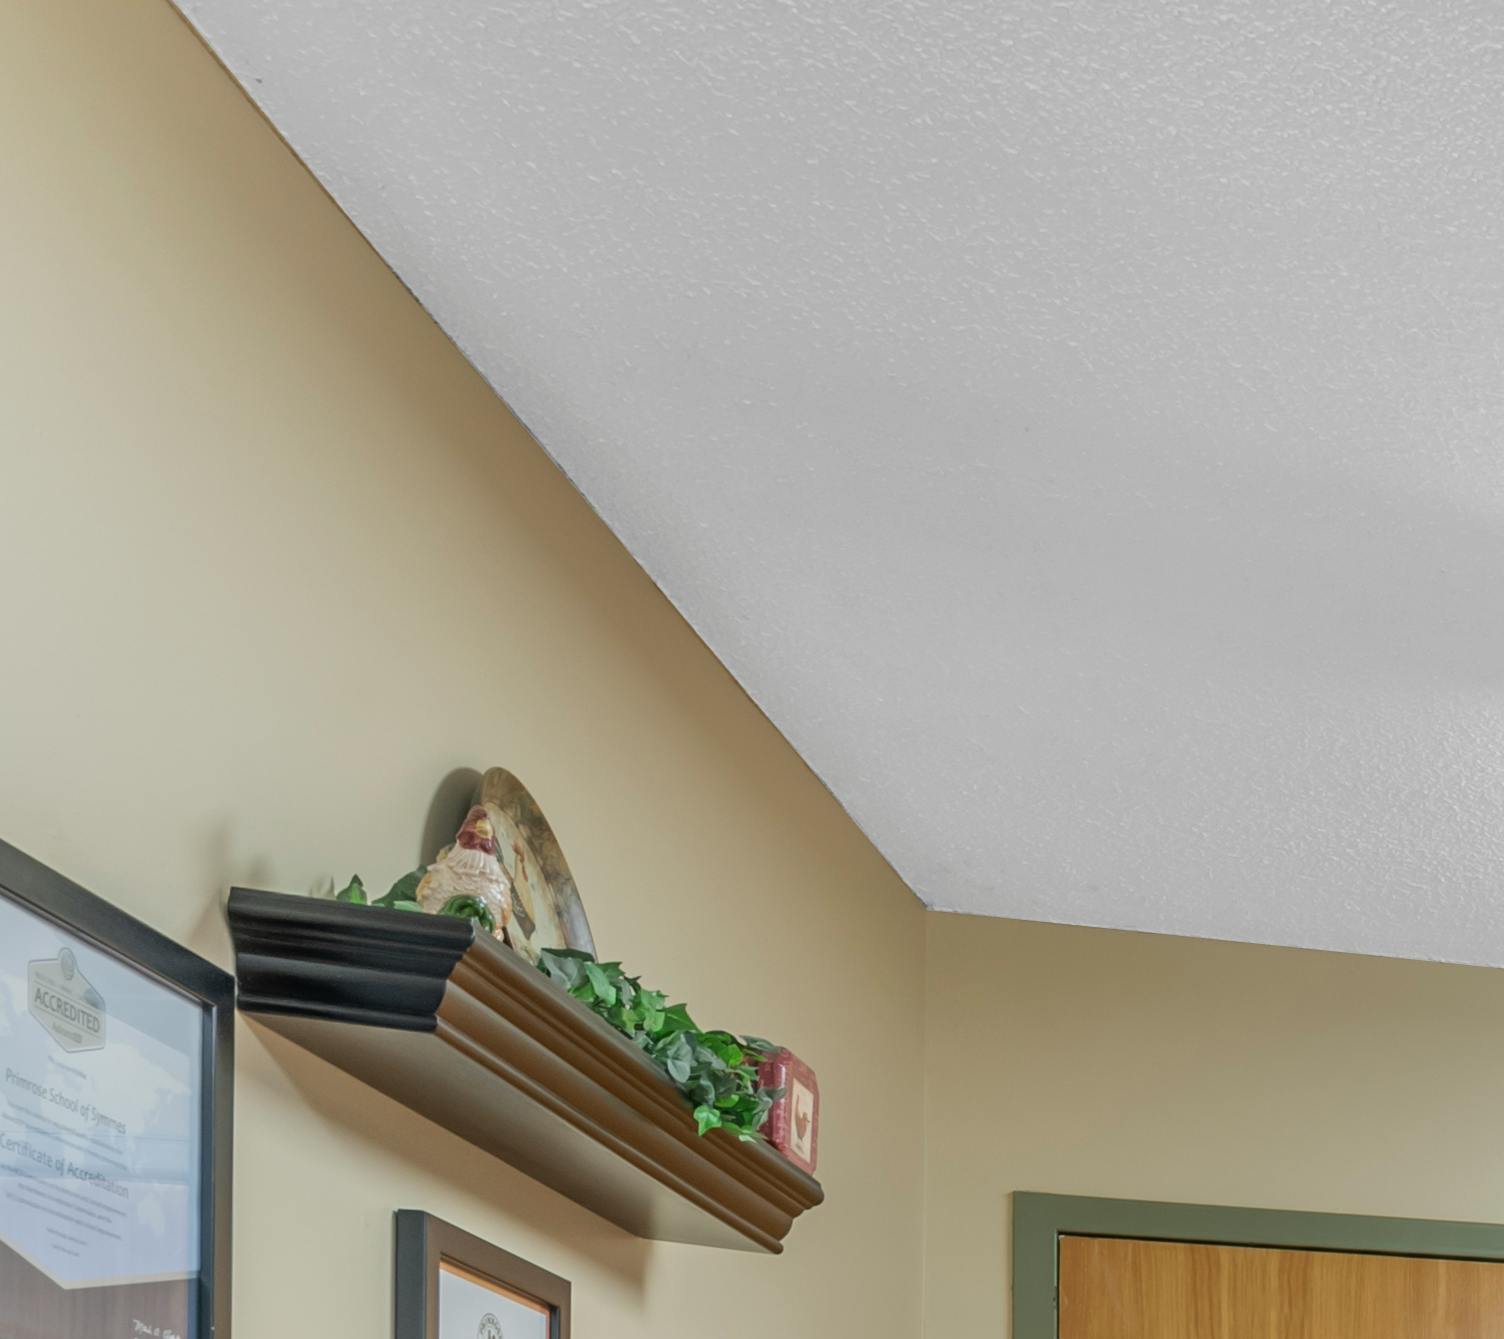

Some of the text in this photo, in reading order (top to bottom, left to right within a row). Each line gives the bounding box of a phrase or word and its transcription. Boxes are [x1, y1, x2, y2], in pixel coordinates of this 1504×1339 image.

[34, 987, 100, 1033] ACCREDITED
[5, 1067, 47, 1099] Primrose
[50, 1087, 79, 1114] School
[80, 1102, 91, 1121] of
[0, 1132, 51, 1170] Certificate
[54, 1157, 66, 1177] of
